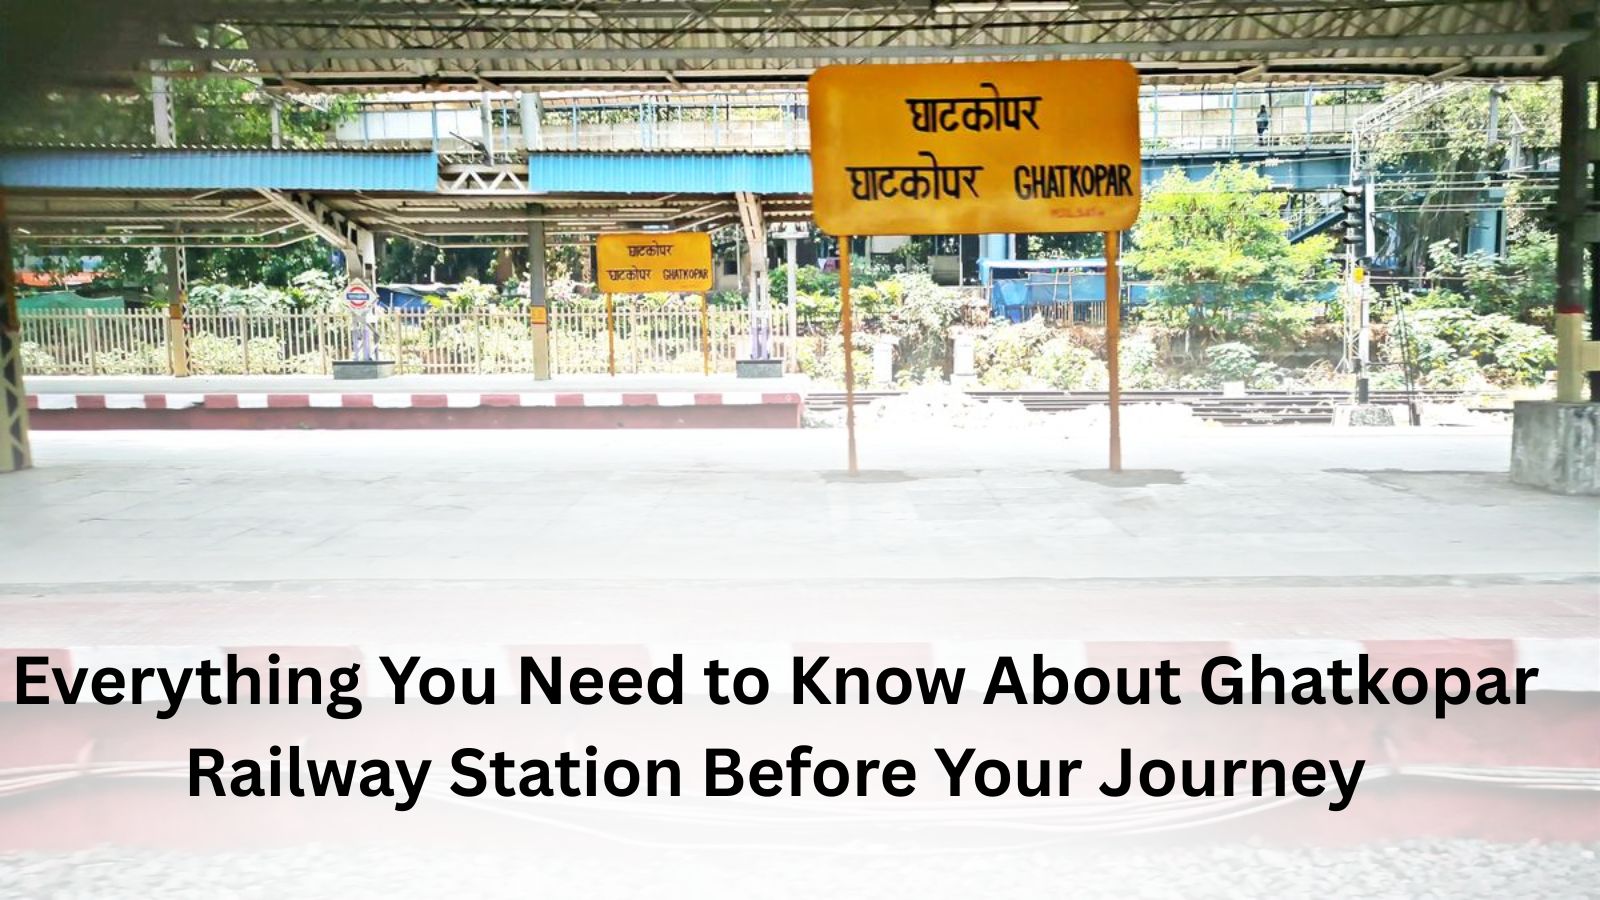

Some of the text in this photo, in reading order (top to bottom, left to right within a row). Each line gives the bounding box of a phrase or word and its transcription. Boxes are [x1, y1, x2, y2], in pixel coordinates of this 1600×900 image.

[905, 82, 1043, 133] घाटकोपर
[844, 151, 985, 201] घाटकोपर
[1014, 164, 1134, 200] GHATKOPAR
[626, 240, 675, 257] घाटकोपर
[662, 268, 709, 281] GHATKOPAR
